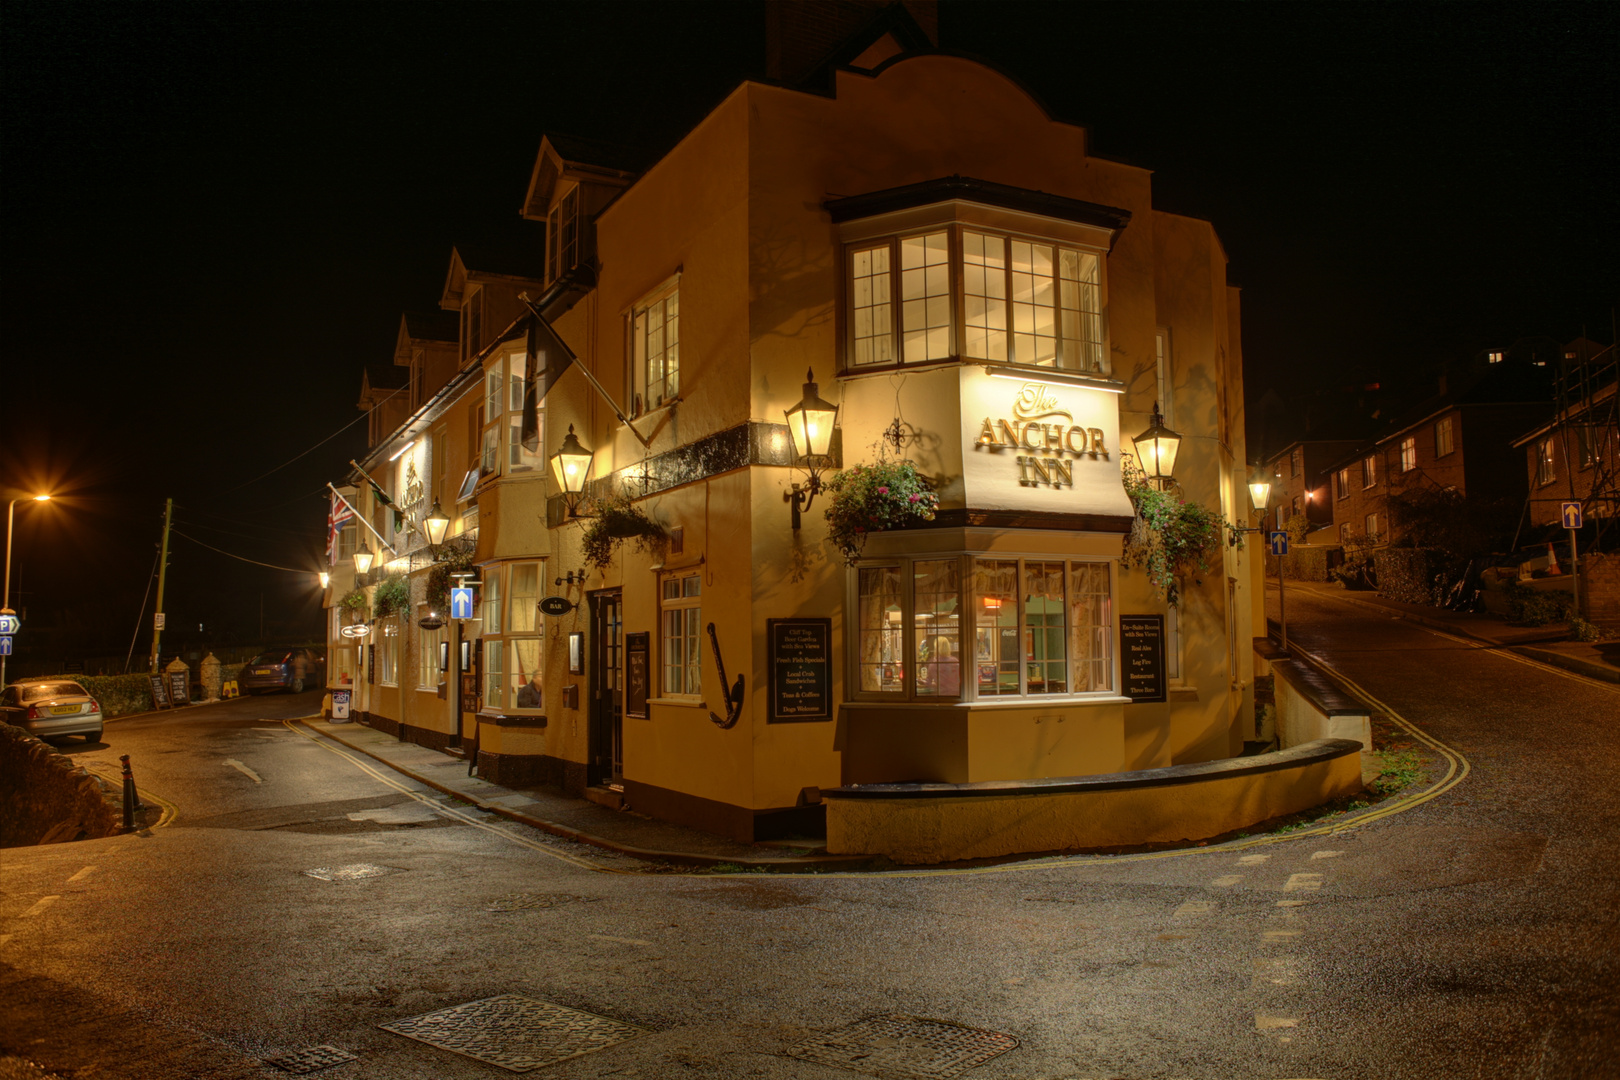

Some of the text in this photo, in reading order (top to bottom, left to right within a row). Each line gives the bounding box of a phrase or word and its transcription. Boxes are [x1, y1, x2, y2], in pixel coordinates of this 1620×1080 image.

[1013, 382, 1073, 423] The
[974, 417, 1110, 457] ANCHOR
[1017, 456, 1073, 487] INN
[0, 621, 8, 631] P
